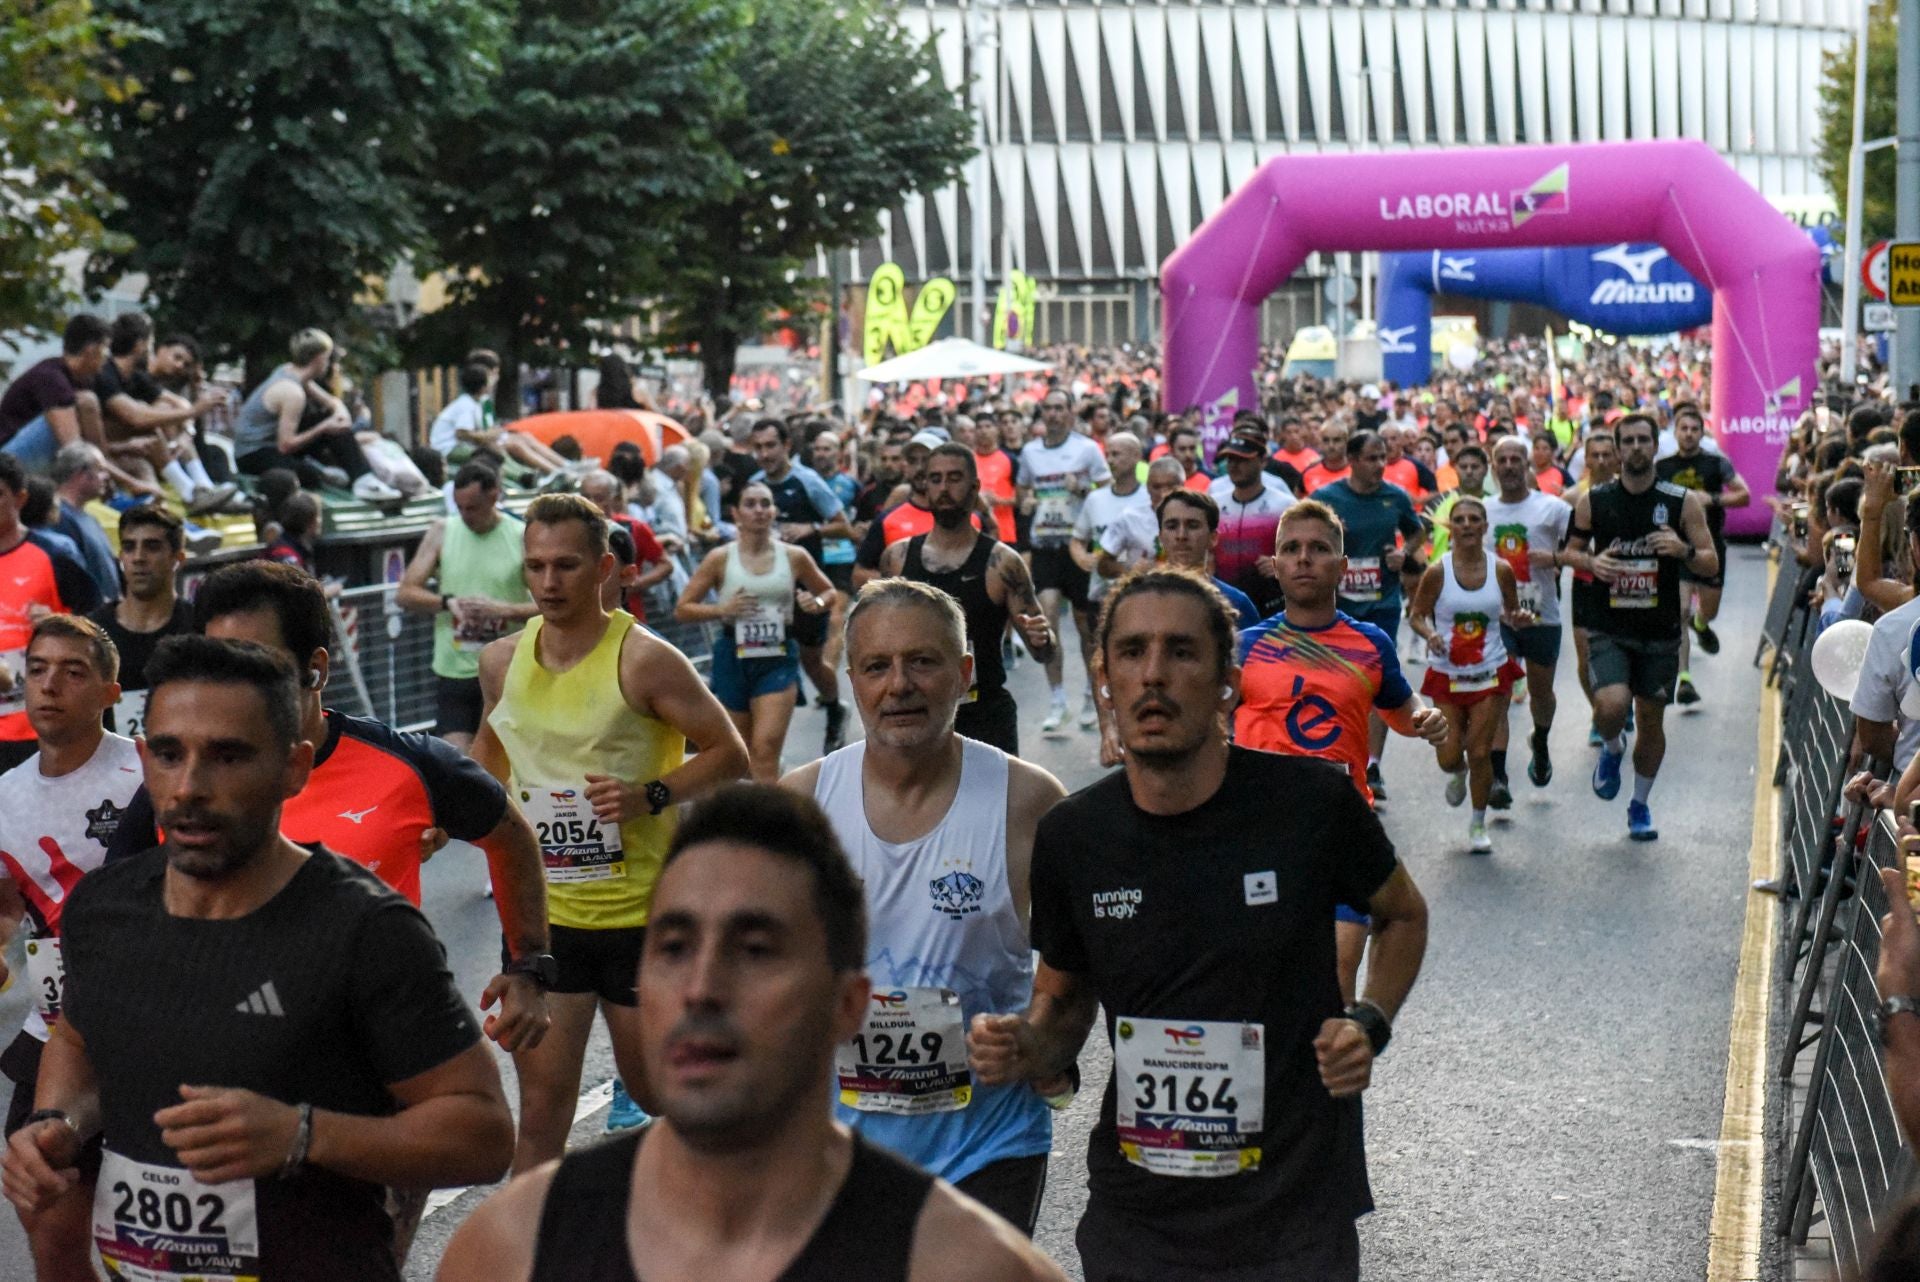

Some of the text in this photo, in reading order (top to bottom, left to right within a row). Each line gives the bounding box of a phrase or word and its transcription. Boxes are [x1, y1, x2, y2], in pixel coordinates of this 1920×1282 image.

[1379, 192, 1508, 220] LABORAL
[1455, 216, 1510, 234] kutxa
[536, 819, 603, 845] 2054
[1093, 887, 1142, 904] running
[1094, 902, 1138, 919] is ugly.
[852, 1032, 943, 1065] 1249
[1135, 1073, 1238, 1114] 3164
[142, 1171, 180, 1185] CELSO
[113, 1181, 226, 1234] 2802
